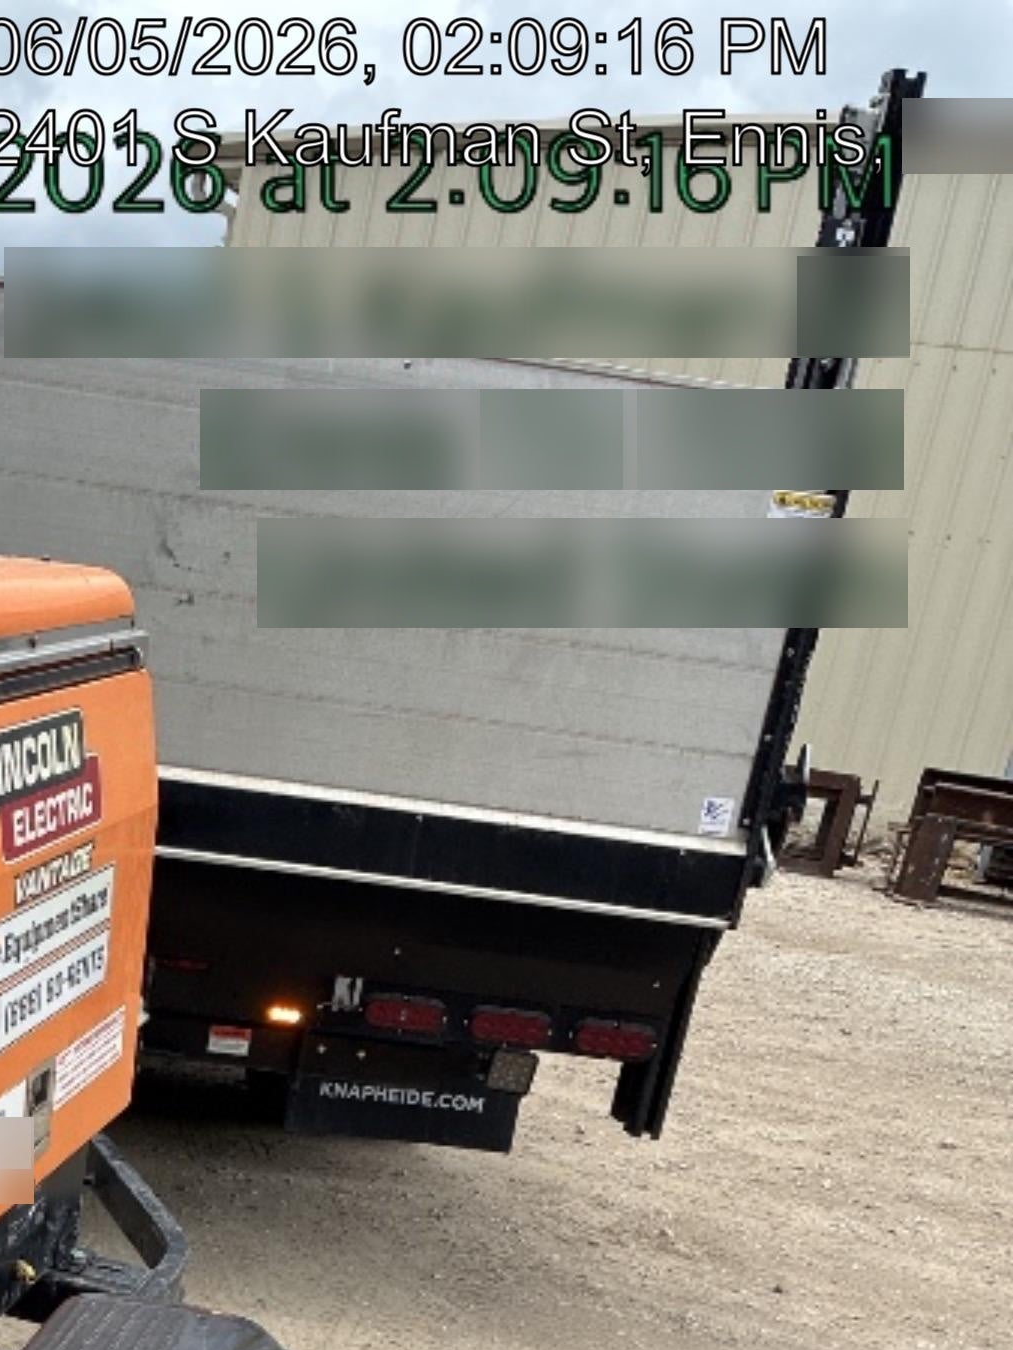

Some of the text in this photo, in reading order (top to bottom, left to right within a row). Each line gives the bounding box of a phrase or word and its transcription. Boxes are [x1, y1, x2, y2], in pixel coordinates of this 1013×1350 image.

[13, 782, 93, 846] ELECTRIC
[16, 843, 93, 905] VANTAGE
[319, 1082, 485, 1114] KNAPHEIDE.COM
